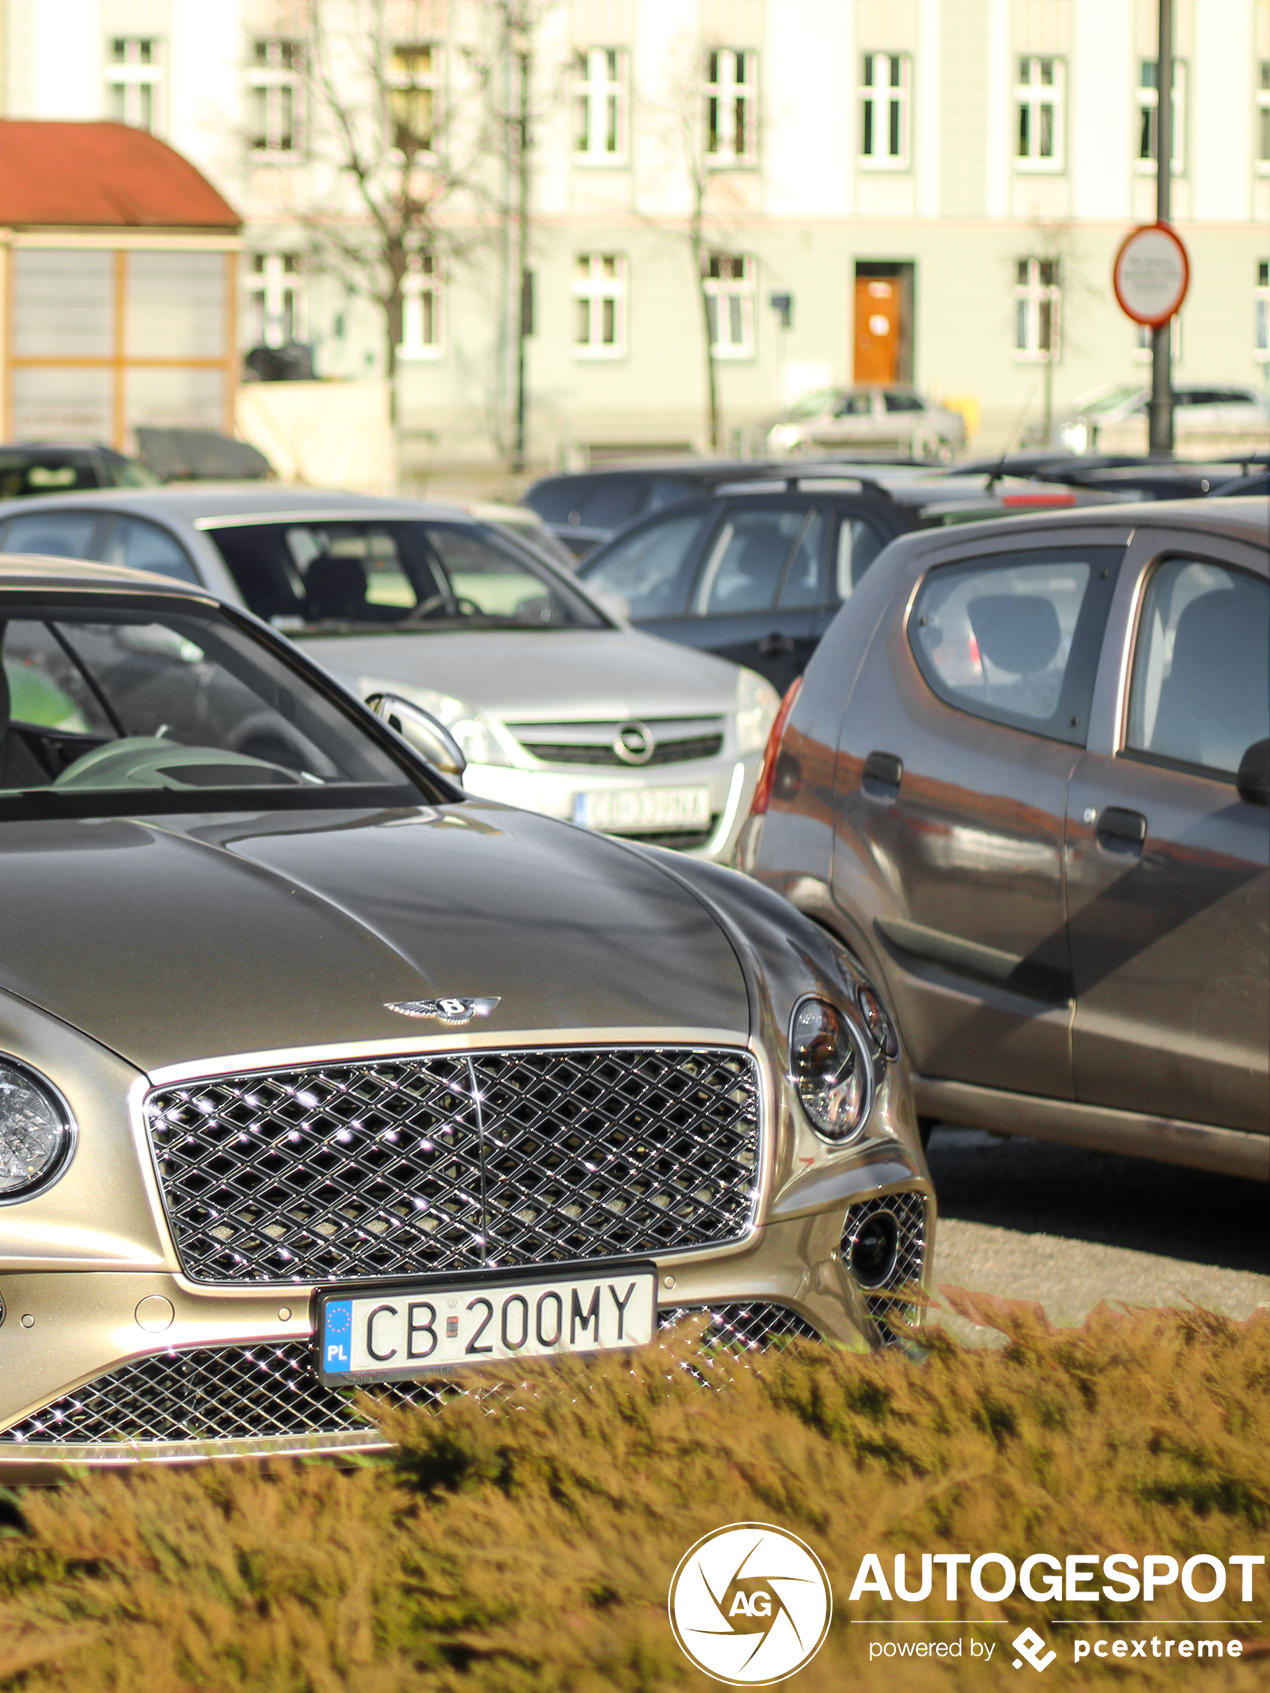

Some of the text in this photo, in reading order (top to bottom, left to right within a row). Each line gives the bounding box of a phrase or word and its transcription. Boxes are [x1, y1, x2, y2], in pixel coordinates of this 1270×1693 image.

[366, 1281, 637, 1362] CB 200MY
[327, 1344, 348, 1362] PL
